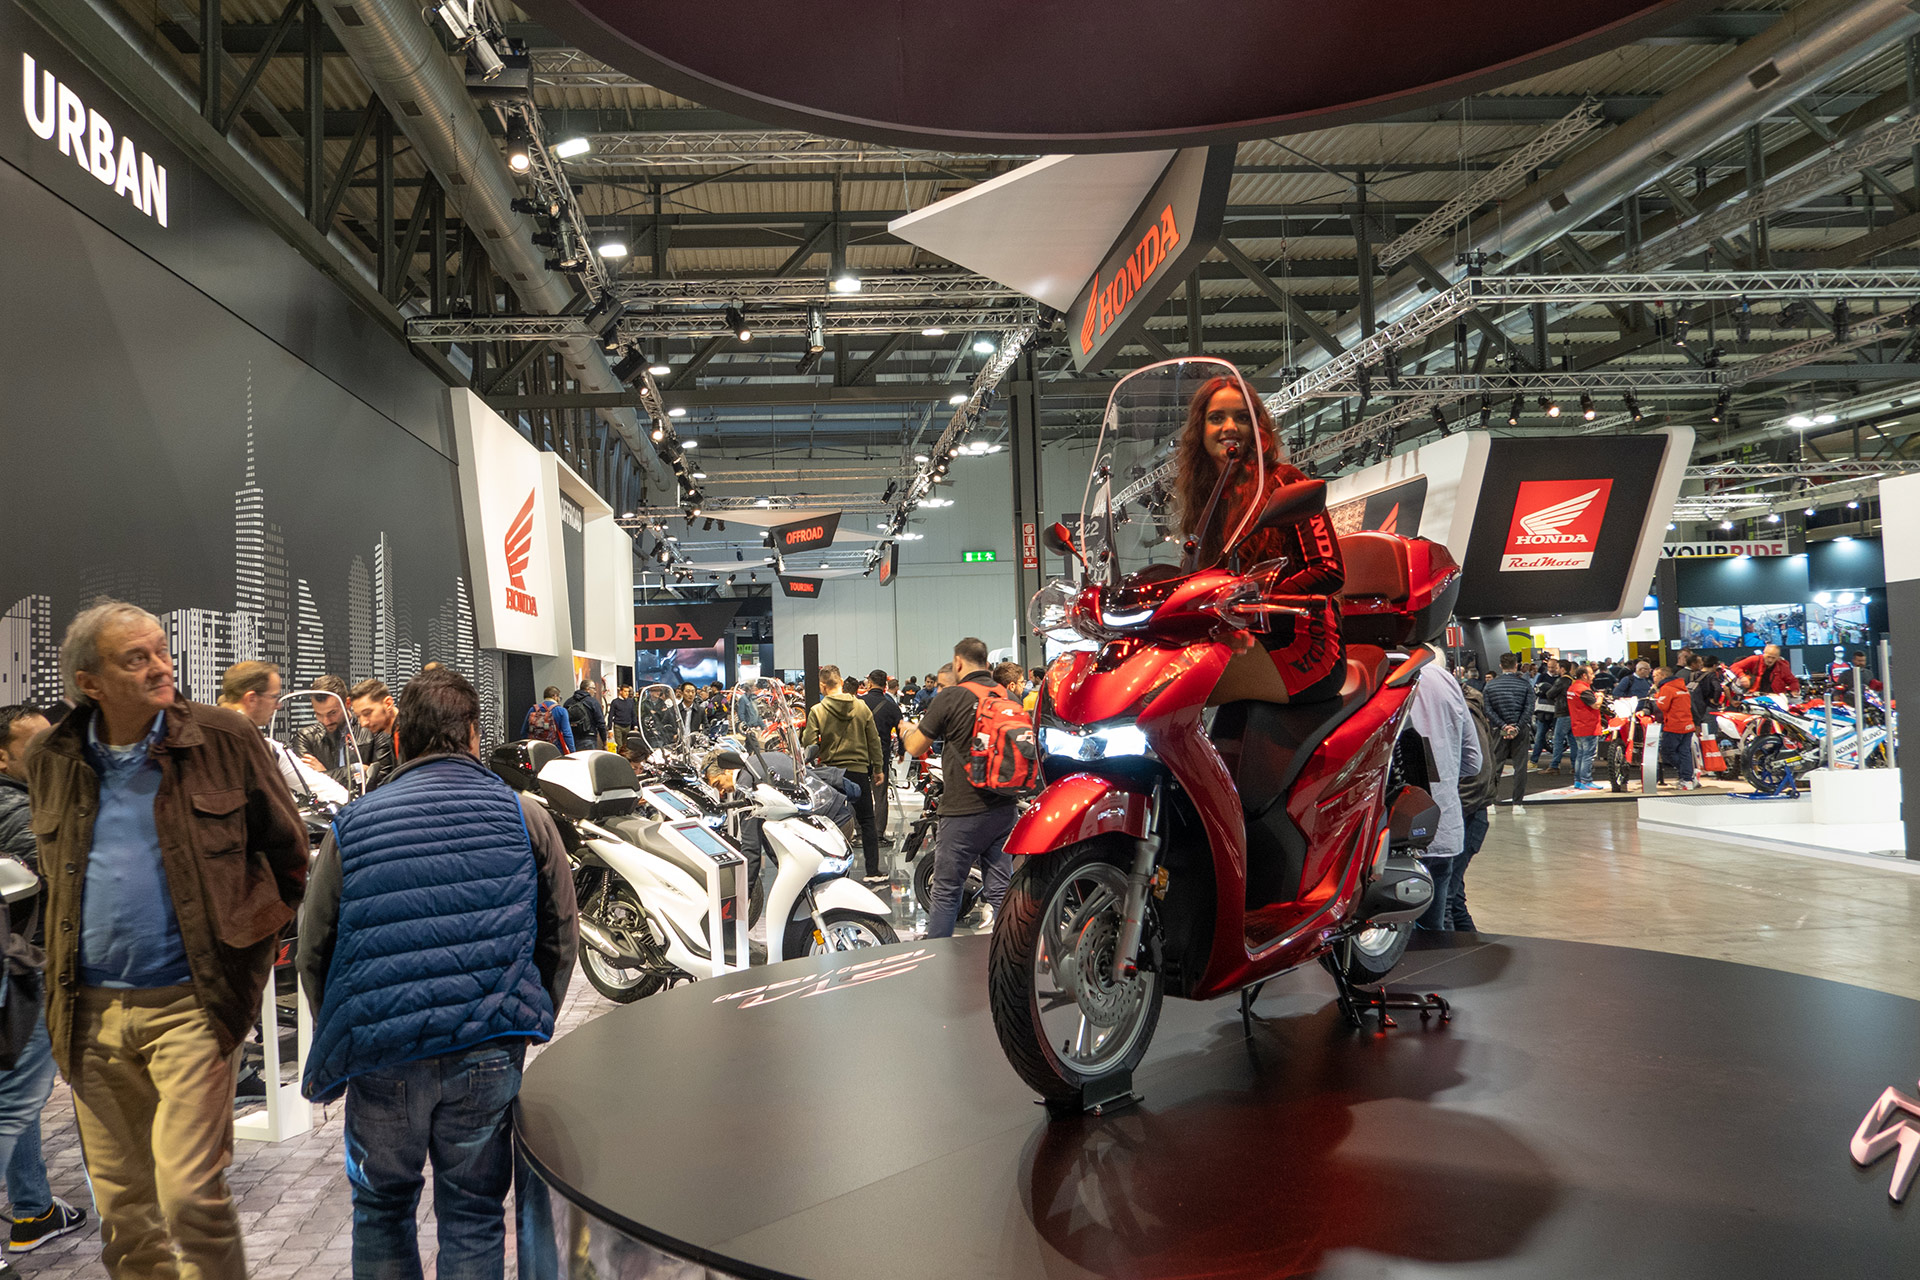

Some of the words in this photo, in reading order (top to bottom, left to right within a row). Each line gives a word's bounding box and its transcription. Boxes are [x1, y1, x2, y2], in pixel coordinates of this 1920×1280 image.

[23, 52, 167, 228] URBAN
[1098, 204, 1180, 336] HONDA
[786, 526, 824, 545] OFFROAD
[1515, 534, 1588, 545] HONDA
[789, 582, 814, 592] TOURING
[506, 587, 538, 617] HONDA
